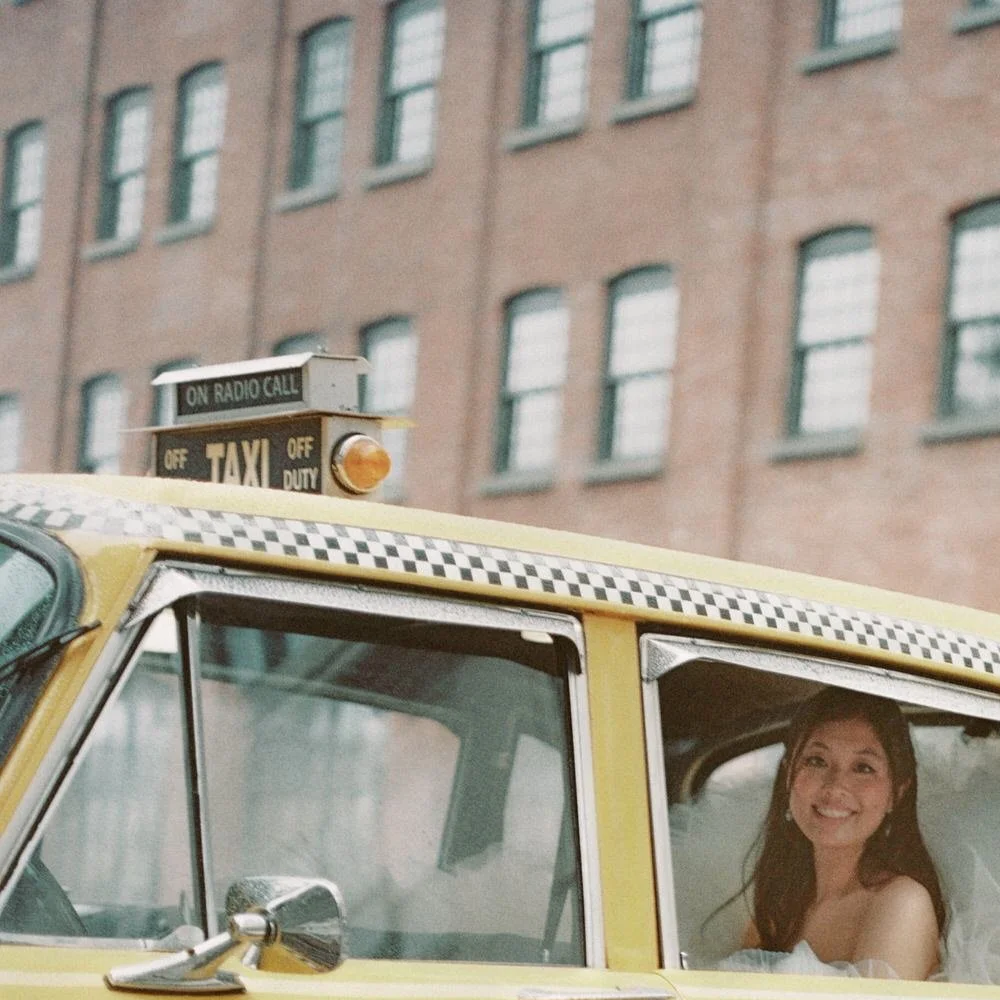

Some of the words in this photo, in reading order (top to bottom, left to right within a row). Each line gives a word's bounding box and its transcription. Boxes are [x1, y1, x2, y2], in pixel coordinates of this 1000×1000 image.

[186, 385, 209, 408] ON
[213, 379, 261, 404] RADIO
[262, 373, 300, 398] CALL
[286, 436, 314, 460] OFF
[163, 447, 189, 471] OFF
[205, 437, 271, 490] TAXI
[282, 466, 319, 492] DUTY
